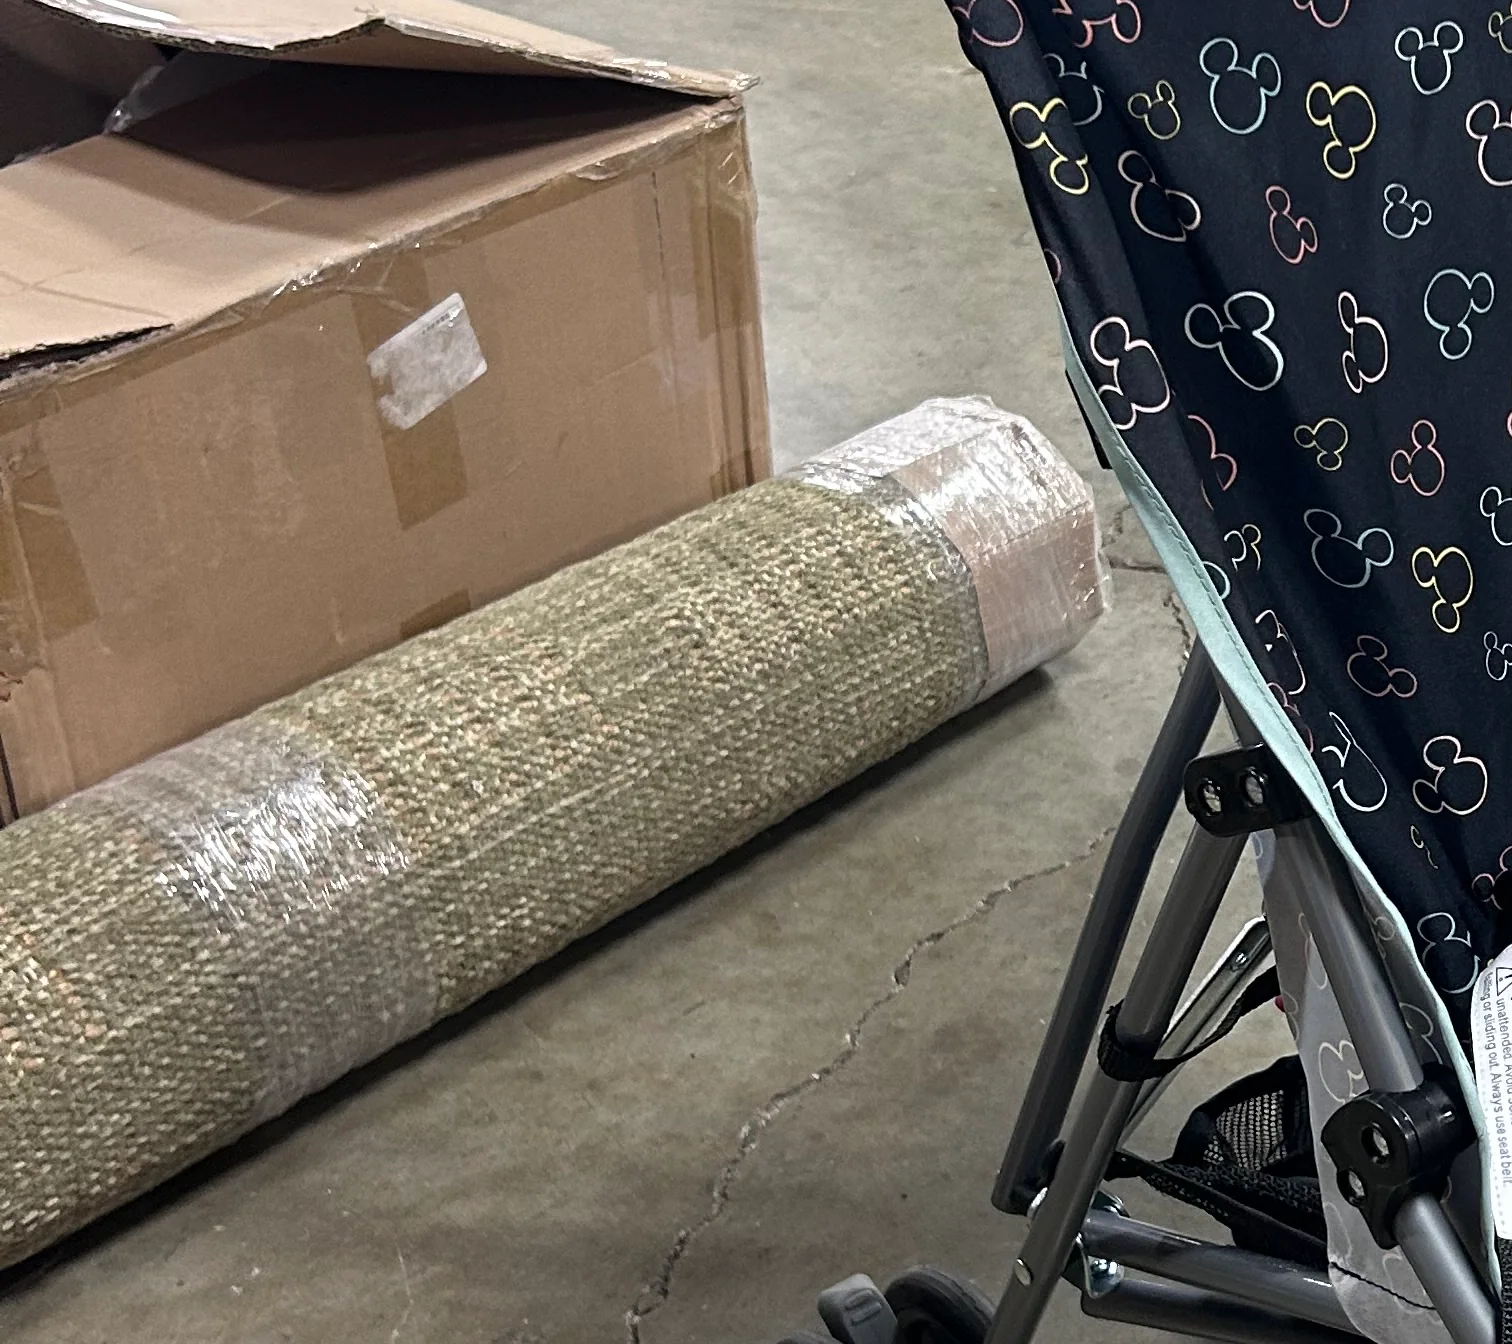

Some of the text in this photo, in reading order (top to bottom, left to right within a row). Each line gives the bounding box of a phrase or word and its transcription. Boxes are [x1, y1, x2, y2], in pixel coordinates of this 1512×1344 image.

[1483, 1001, 1493, 1012] or
[1484, 1014, 1497, 1051] sliding
[1490, 1072, 1503, 1113] Always
[1495, 1116, 1507, 1135] use
[1497, 1137, 1512, 1159] seat
